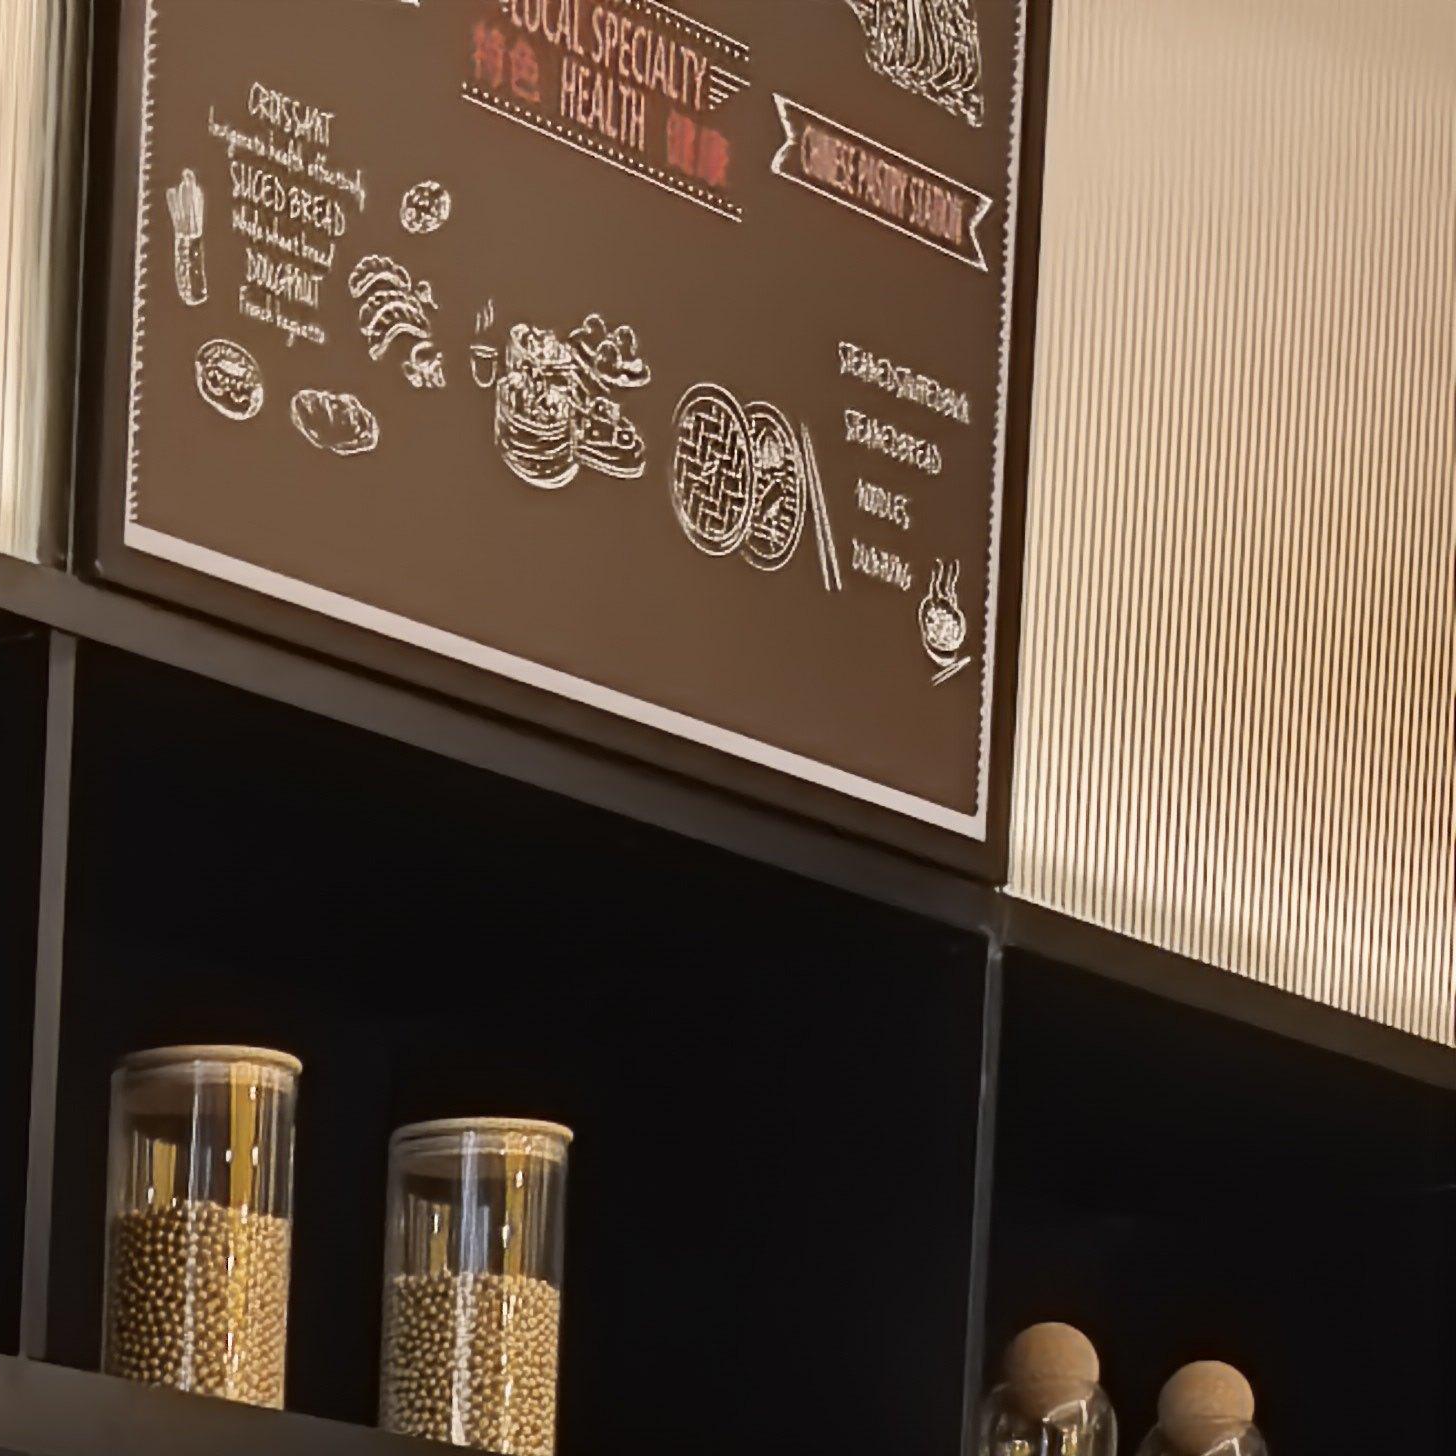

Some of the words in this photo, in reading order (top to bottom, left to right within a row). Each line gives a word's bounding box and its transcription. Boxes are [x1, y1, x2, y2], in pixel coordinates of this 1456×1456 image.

[560, 56, 646, 152] HEALTH
[591, 6, 708, 112] SPECIALTY
[230, 161, 286, 212] SLICED
[289, 187, 345, 236] BREAD
